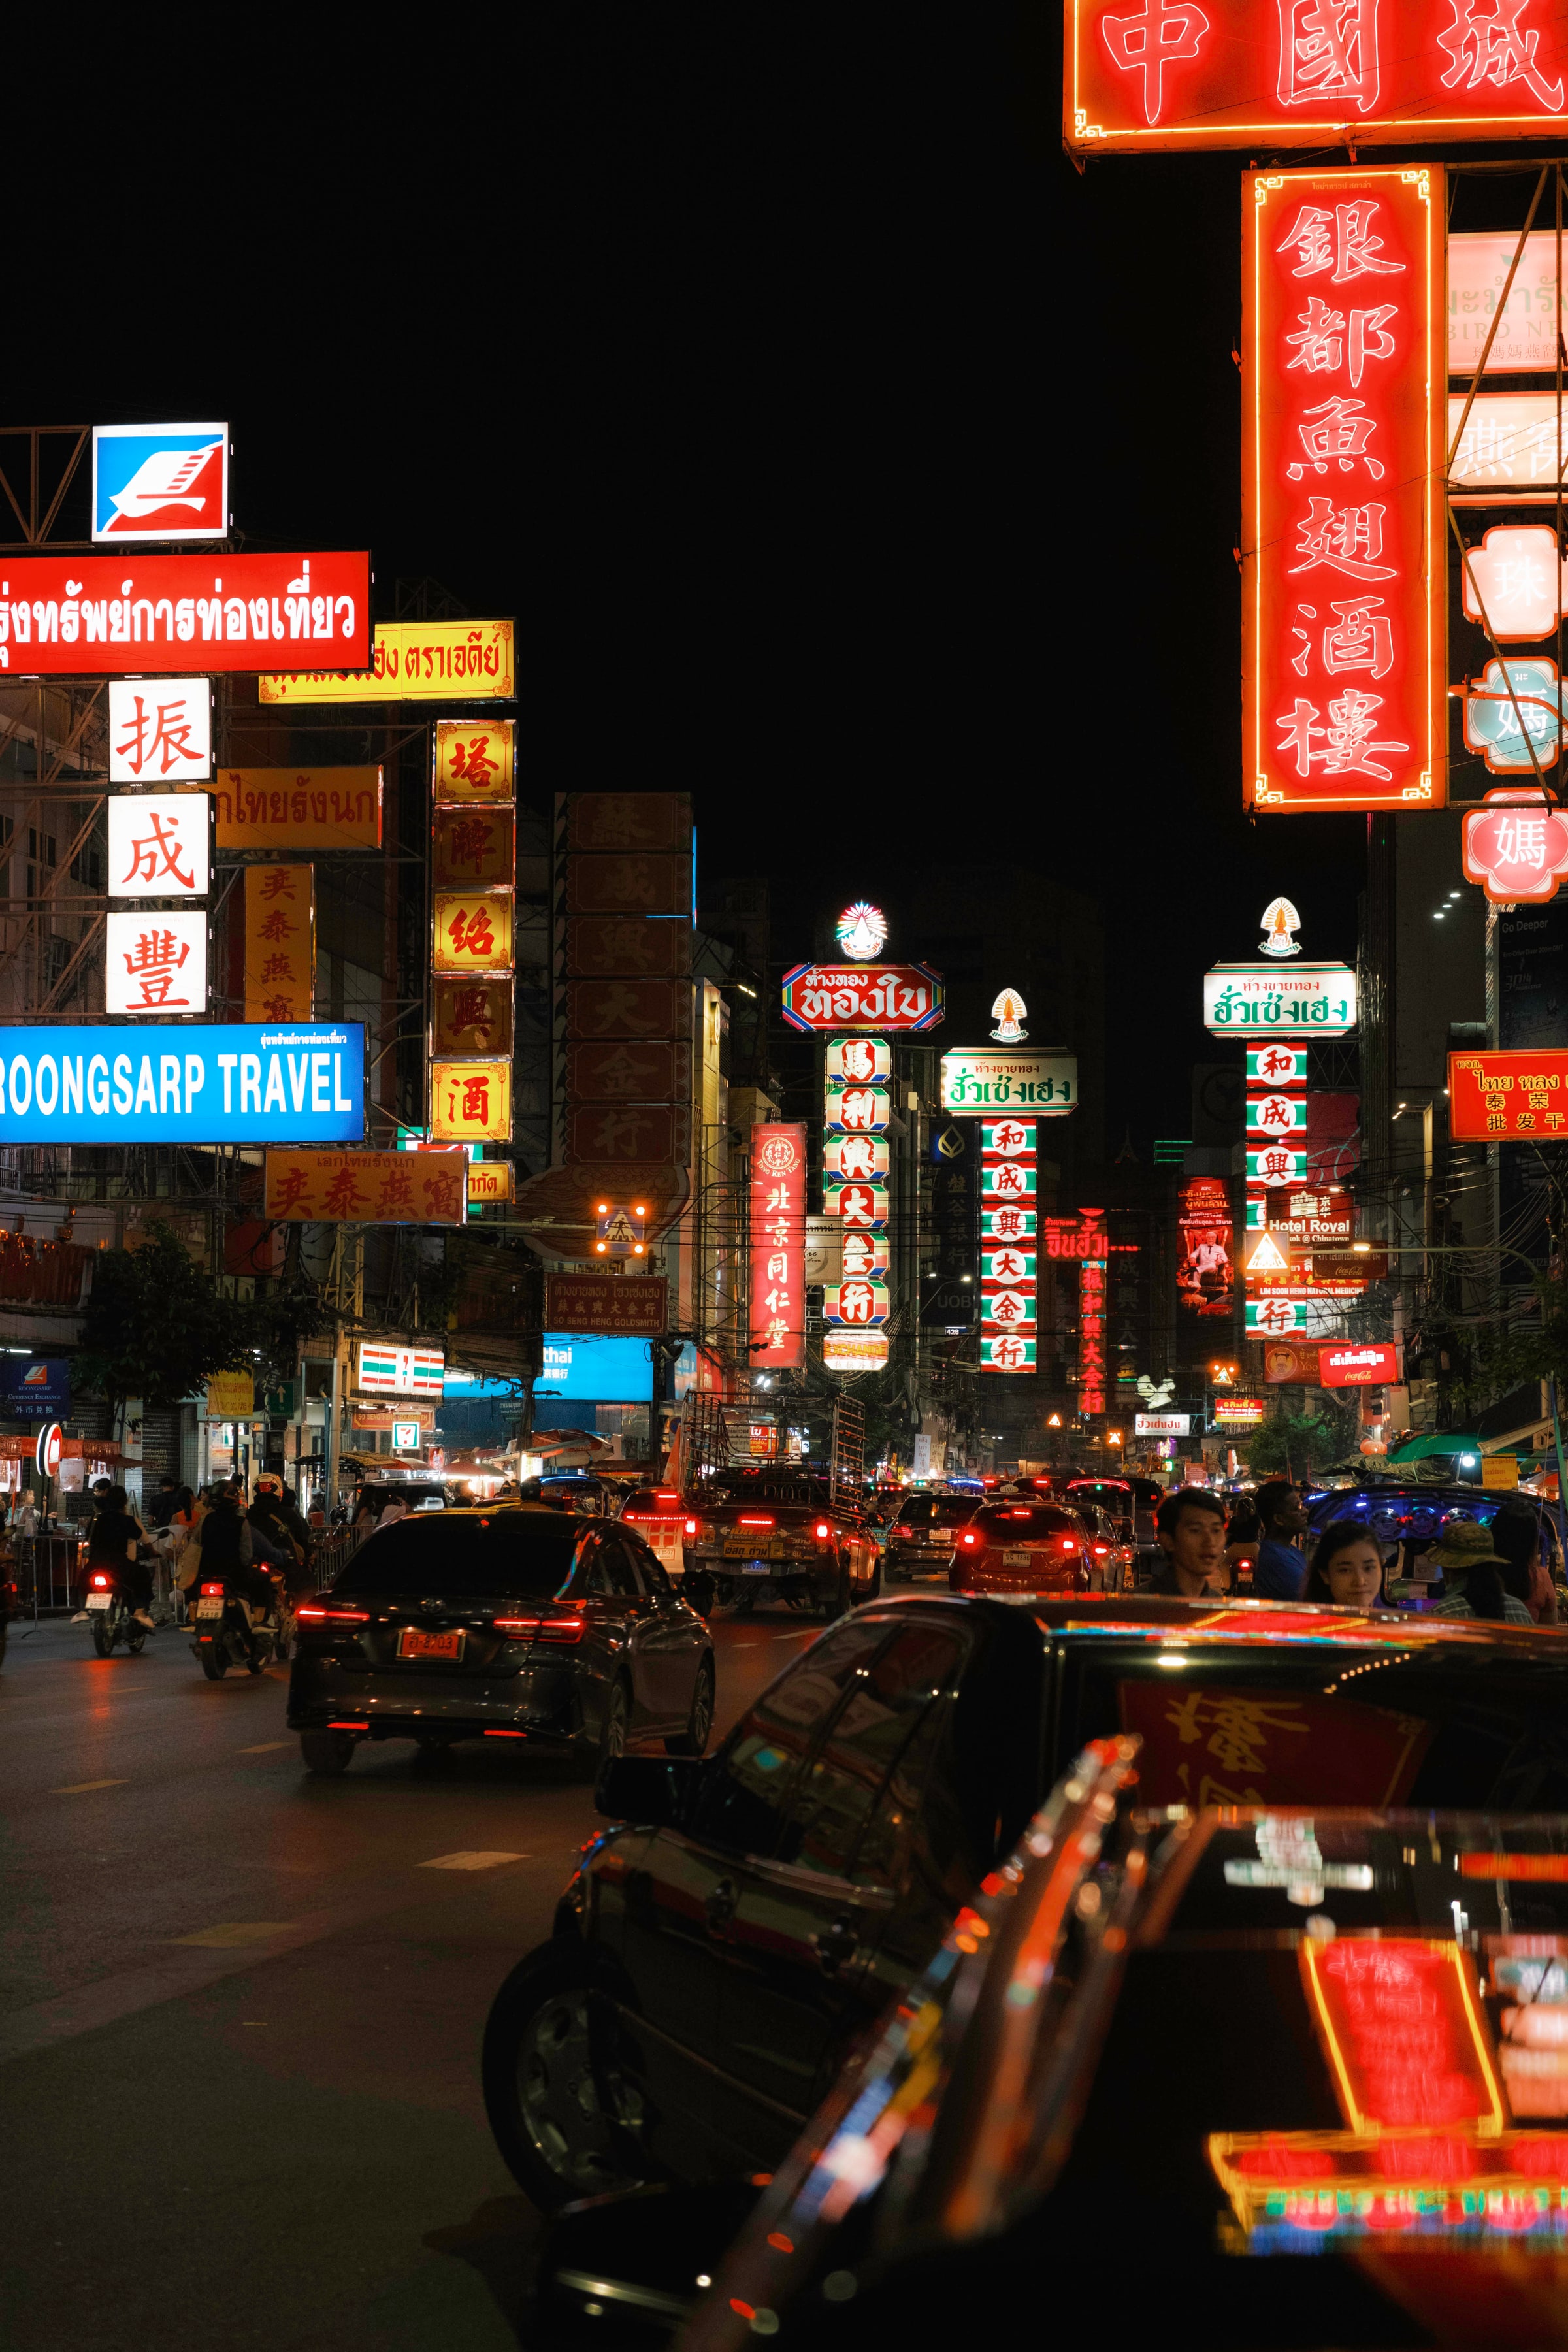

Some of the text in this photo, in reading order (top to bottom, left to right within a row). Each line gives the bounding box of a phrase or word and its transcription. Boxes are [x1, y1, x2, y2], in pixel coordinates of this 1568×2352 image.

[1102, 0, 1564, 125] 中國城
[1276, 200, 1409, 781] 銀都魚翅酒樓
[216, 773, 375, 823] กไทยรังนก
[1516, 919, 1548, 932] Deeper
[804, 970, 868, 986] ห้างทอง
[1242, 977, 1320, 992] ห้างขายทอง
[800, 973, 927, 1019] ทองใบ
[1213, 985, 1347, 1024] ฮั่วเซ่งเฮง
[975, 1060, 1040, 1074] ห้างขายทอง
[0, 1053, 351, 1115] OONGSARP TRAVEL
[950, 1067, 1070, 1103] ฮั่วเซ่งเฮง
[1473, 1070, 1560, 1091] ไทย หลง
[757, 1158, 770, 1175] TONG
[786, 1158, 800, 1174] TANG
[468, 1171, 498, 1193] ำกัด
[1269, 1219, 1350, 1233] Hotel Royal
[764, 1181, 791, 1350] 北京同仁堂
[937, 1295, 972, 1308] UOB
[614, 1318, 659, 1327] GOLDSMITH
